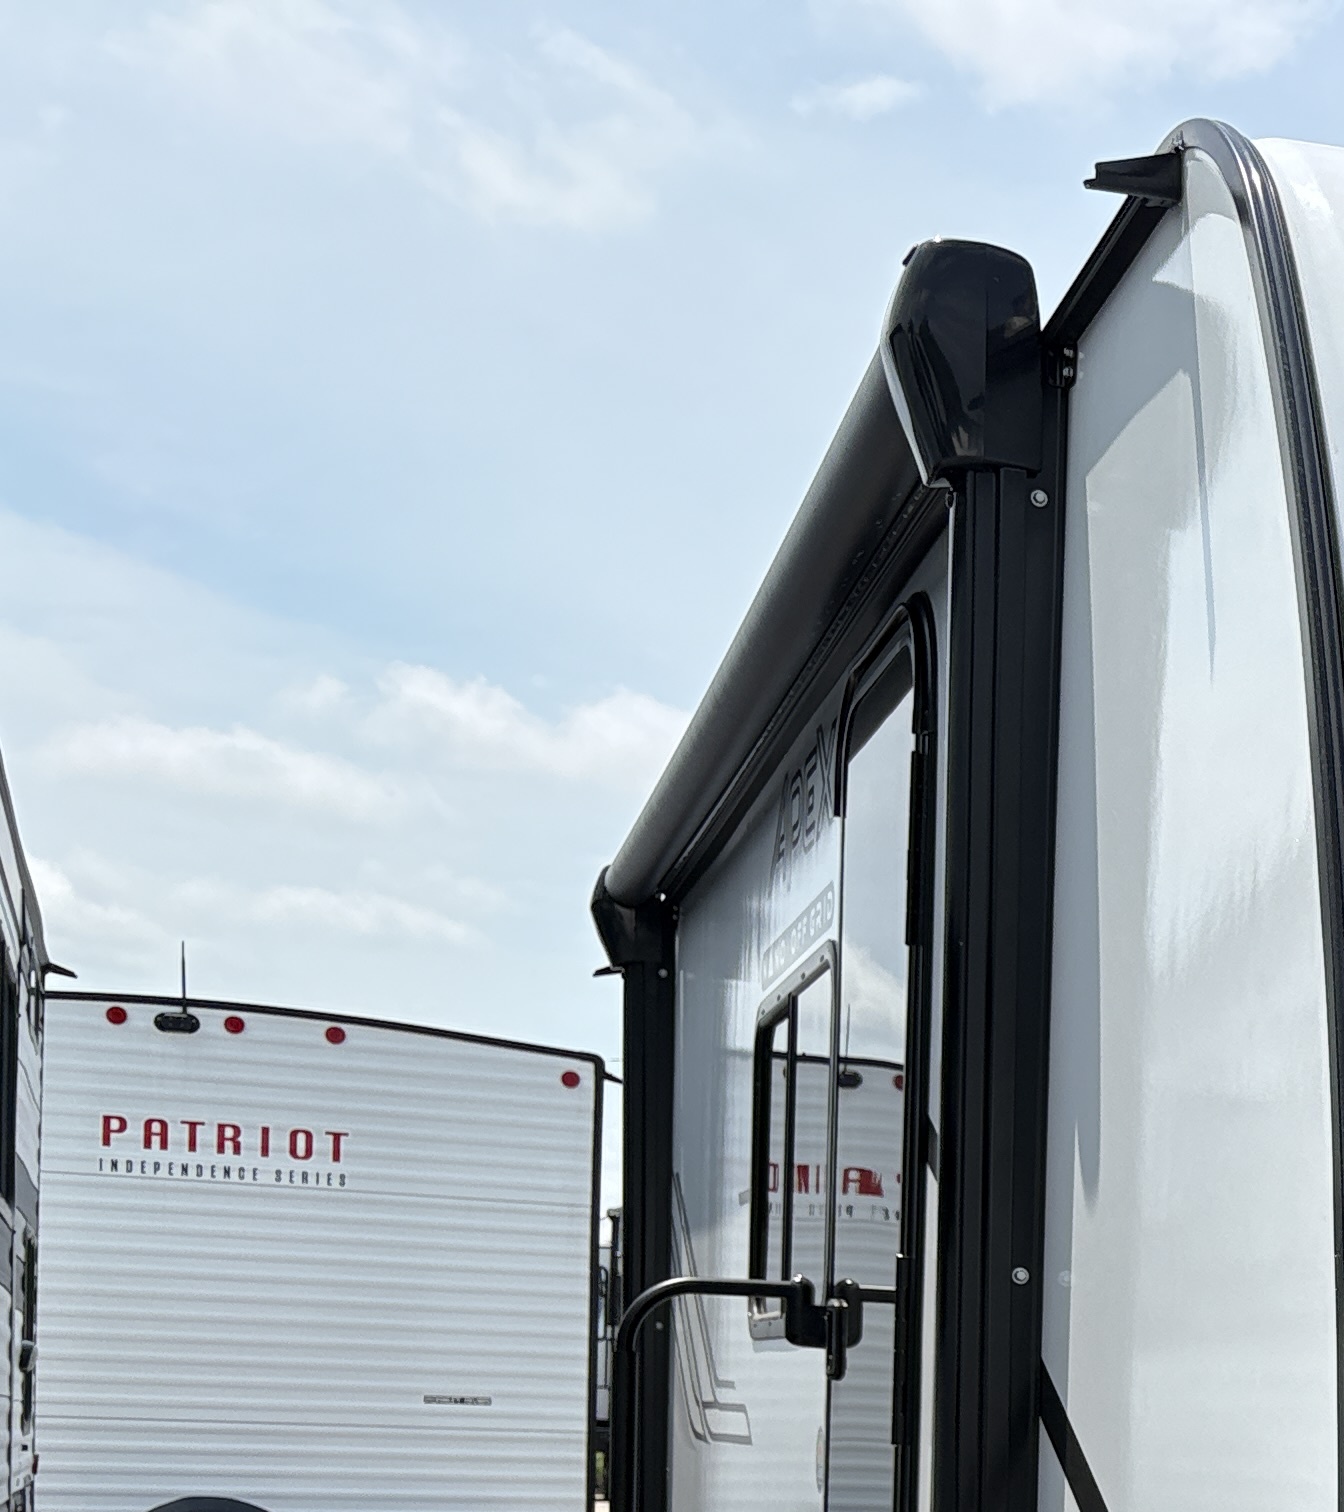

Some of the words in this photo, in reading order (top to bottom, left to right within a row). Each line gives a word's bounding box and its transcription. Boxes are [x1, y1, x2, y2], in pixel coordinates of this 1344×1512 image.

[101, 1114, 349, 1163] PATRIOT
[98, 1157, 259, 1182] INDEPENDENCE
[275, 1169, 346, 1187] SERIES
